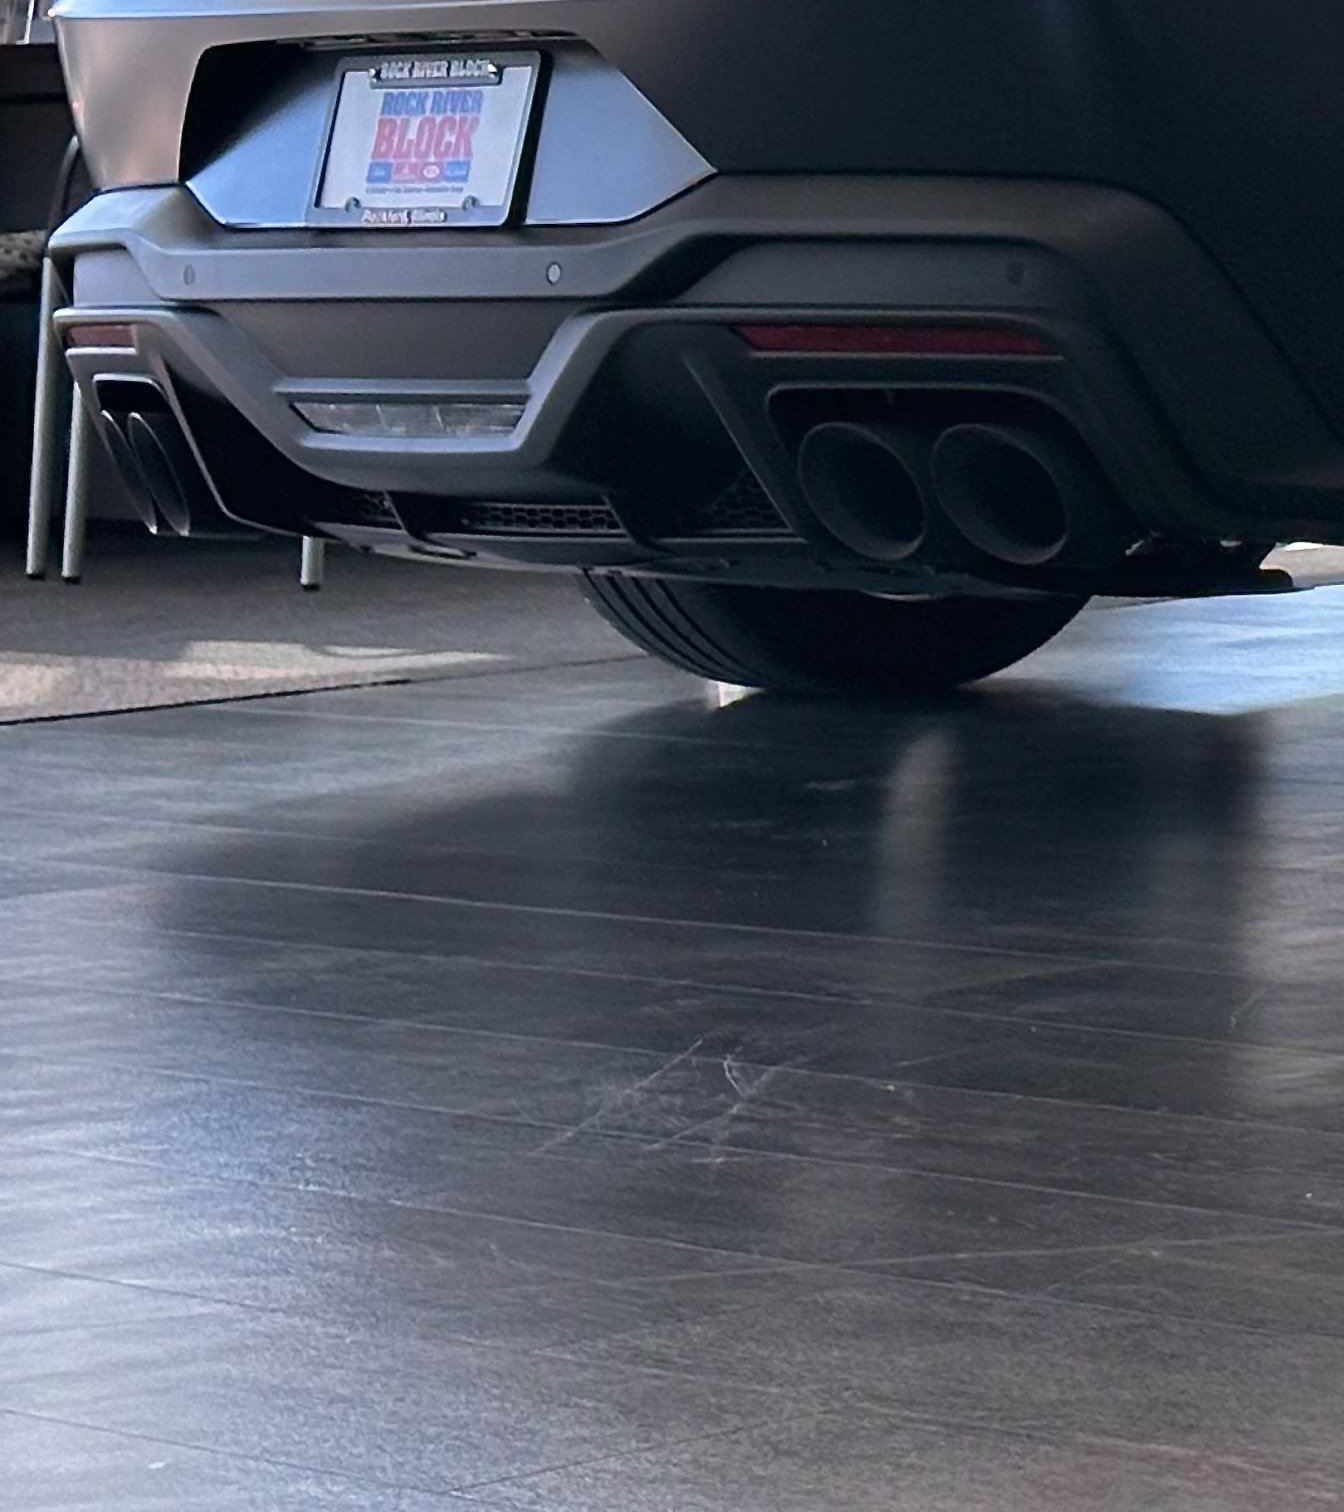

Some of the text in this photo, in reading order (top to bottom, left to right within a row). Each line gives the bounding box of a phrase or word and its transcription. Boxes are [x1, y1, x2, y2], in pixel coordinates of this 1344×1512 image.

[379, 58, 491, 79] ROCK RIVER BLOCK
[380, 89, 485, 115] ROCK RIVER
[370, 115, 481, 160] BLOCK
